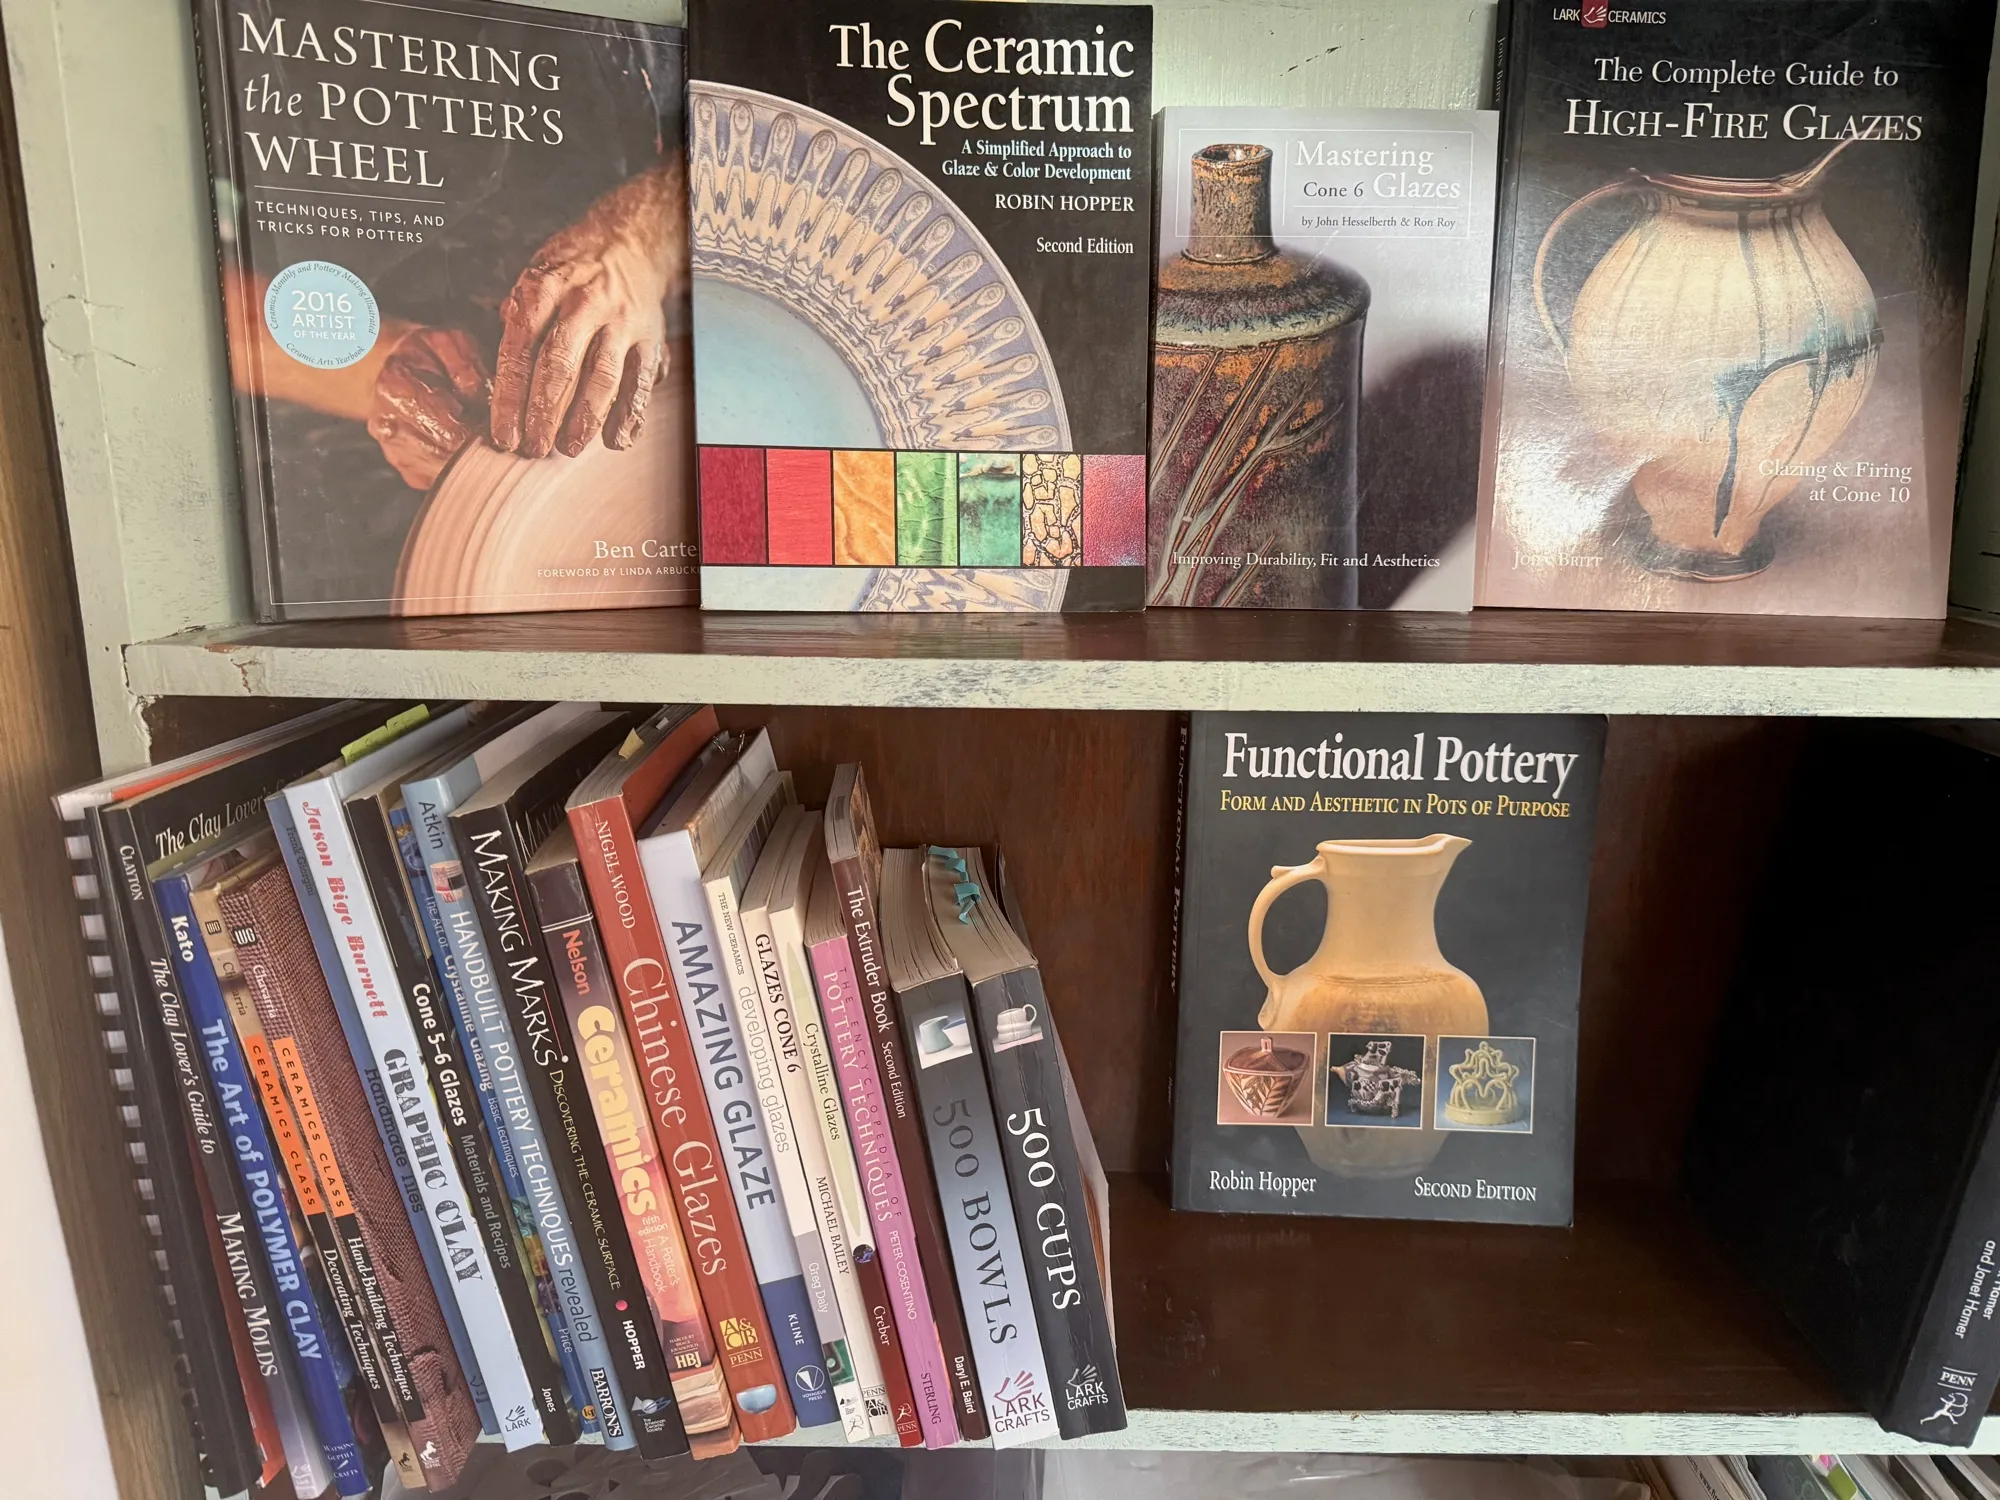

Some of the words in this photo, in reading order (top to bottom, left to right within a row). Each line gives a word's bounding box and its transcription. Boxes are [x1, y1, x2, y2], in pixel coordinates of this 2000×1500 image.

[1553, 7, 1580, 22] LARK
[1607, 10, 1666, 25] CERAMICS
[238, 12, 561, 91] MASTERING
[829, 22, 910, 70] The
[924, 19, 1135, 77] Ceramic
[1595, 58, 1643, 83] The
[1652, 60, 1776, 93] Complete
[1785, 61, 1864, 87] Guide
[1873, 68, 1899, 87] to
[244, 73, 303, 117] the
[318, 81, 564, 145] POTTER'S
[886, 74, 1134, 145] Spectrum
[1564, 98, 1769, 140] HIGH-FIRE
[1783, 104, 1923, 142] GLAZES
[245, 131, 445, 188] WHEEL
[942, 160, 980, 177] Glaze
[1003, 163, 1040, 178] Color
[1044, 163, 1131, 184] Development
[962, 140, 972, 154] A
[976, 140, 1044, 160] Simplified
[1049, 142, 1114, 161] Approach
[1118, 145, 1131, 158] to
[1295, 141, 1434, 175] Mastering
[995, 194, 1054, 210] ROBIN
[1060, 195, 1135, 212] HOPPER
[1303, 181, 1347, 197] Cone
[1354, 182, 1364, 197] 6
[1373, 173, 1461, 198] Glazes
[255, 201, 363, 221] TECHNIQUES,
[369, 210, 407, 226] TIPS,
[413, 213, 445, 227] AND
[257, 220, 314, 235] TRICKS
[320, 223, 350, 238] FOR
[356, 226, 423, 243] POTTERS
[1301, 216, 1313, 228] by
[1315, 216, 1338, 227] John
[1342, 217, 1397, 227] Hesselberth
[1414, 217, 1433, 227] Ron
[1437, 218, 1456, 230] Roy
[1036, 237, 1083, 253] Second
[1087, 238, 1134, 254] Edition
[292, 290, 352, 313] 2016
[292, 314, 355, 329] ARTIST
[1758, 460, 1827, 483] Glazing
[1855, 462, 1912, 485] Firing
[1809, 487, 1827, 502] at
[1832, 486, 1883, 503] Cone
[1889, 486, 1910, 504] 10
[593, 540, 635, 559] Ben
[642, 539, 699, 558] Carte
[1172, 552, 1242, 569] Improving
[1247, 553, 1317, 569] Durability,
[1320, 553, 1339, 566] Fit
[1342, 554, 1368, 567] and
[1372, 554, 1441, 568] Aesthetics
[538, 568, 599, 577] FOREWORD
[603, 568, 616, 576] BY
[620, 567, 652, 576] LINDA
[1223, 732, 1425, 781] Functional
[1434, 735, 1579, 799] Pottery
[1220, 789, 1268, 812] FORM
[1271, 794, 1306, 812] AND
[1310, 791, 1399, 815] AESTHETIC
[1403, 798, 1422, 815] IN
[1426, 794, 1467, 816] POTS
[1472, 800, 1492, 816] OF
[1497, 796, 1570, 818] PURPOSE
[418, 801, 444, 850] Atkin
[120, 845, 144, 901] CLAYTON
[595, 820, 619, 873] NIGEL
[611, 874, 636, 929] WOOD
[302, 801, 333, 867] Jason
[327, 876, 353, 926] Bige
[346, 935, 389, 1018] Burnett
[847, 885, 864, 919] The
[171, 916, 194, 962] Kato
[470, 830, 525, 954] MAKING
[507, 956, 558, 1067] MARKS
[728, 932, 745, 975] CERAMICS
[855, 920, 882, 986] Extruder
[563, 929, 591, 996] Nelson
[755, 933, 784, 1004] GLAZES
[773, 1007, 798, 1060] CONE
[787, 1063, 802, 1073] 6
[871, 991, 894, 1034] Book
[202, 1019, 229, 1072] The
[671, 921, 743, 1091] AMAZING
[723, 1100, 776, 1210] GLAZE
[882, 1041, 900, 1083] Second
[738, 986, 775, 1090] developing
[762, 1094, 789, 1153] glazes
[804, 1022, 829, 1095] Crystalline
[823, 1097, 840, 1141] Glazes
[188, 1090, 213, 1135] Guide
[219, 1081, 250, 1127] Art
[577, 1005, 657, 1216] Ceramics
[623, 957, 687, 1128] Chinese
[672, 1141, 727, 1276] Glazes
[823, 971, 859, 1070] POTTERY
[848, 1079, 893, 1222] TECHNIQUES
[890, 1082, 906, 1119] Edition
[252, 1045, 292, 1139] CERAMICS
[290, 1151, 316, 1206] CLASS
[282, 1048, 321, 1141] CERAMICS
[319, 1153, 345, 1208] CLASS
[412, 983, 437, 1030] Cone
[439, 1068, 468, 1127] Glazes
[460, 1134, 488, 1194] Materials
[488, 1220, 511, 1269] Recipes
[450, 910, 505, 1034] HANDBUILT
[489, 1042, 535, 1132] POTTERY
[520, 1139, 574, 1267] TECHNIQUES
[558, 1268, 599, 1343] revealed
[235, 1135, 264, 1162] of
[383, 1048, 448, 1190] GRAPHIC
[435, 1200, 483, 1283] CLAY
[1209, 1170, 1255, 1191] Robin
[1258, 1171, 1317, 1198] Hopper
[816, 1176, 838, 1233] MICHAEL
[831, 1233, 850, 1275] BAILEY
[932, 1098, 980, 1179] 500
[961, 1191, 1018, 1345] BOWLS
[1006, 1107, 1056, 1188] 500
[1036, 1201, 1082, 1310] CUPS
[246, 1169, 300, 1292] POLYMER
[1980, 1240, 1996, 1265] and
[216, 1212, 256, 1300] MAKING
[244, 1305, 279, 1377] MOLDS
[808, 1262, 824, 1288] Greg
[1969, 1264, 1991, 1297] Janet
[323, 1249, 354, 1318] Decorating
[350, 1320, 381, 1391] Techniques
[347, 1237, 388, 1330] Hand-Building
[382, 1331, 413, 1402] Techniques
[813, 1288, 828, 1313] Daly
[1955, 1299, 1981, 1339] Hamer
[286, 1301, 323, 1360] CLAY
[622, 1319, 646, 1371] HOPPER
[788, 1313, 804, 1345] KLINE
[873, 1305, 890, 1346] Creber
[675, 1351, 702, 1368] HBJ
[730, 1350, 763, 1365] PENN
[541, 1387, 557, 1413] Jones
[920, 1372, 942, 1425] STERLING
[1065, 1381, 1106, 1401] LARK
[1940, 1371, 1977, 1388] PENN
[992, 1391, 1047, 1419] LARK
[994, 1408, 1051, 1434] CRAFTS
[1066, 1393, 1109, 1410] CRAFTS
[504, 1416, 532, 1432] LARK
